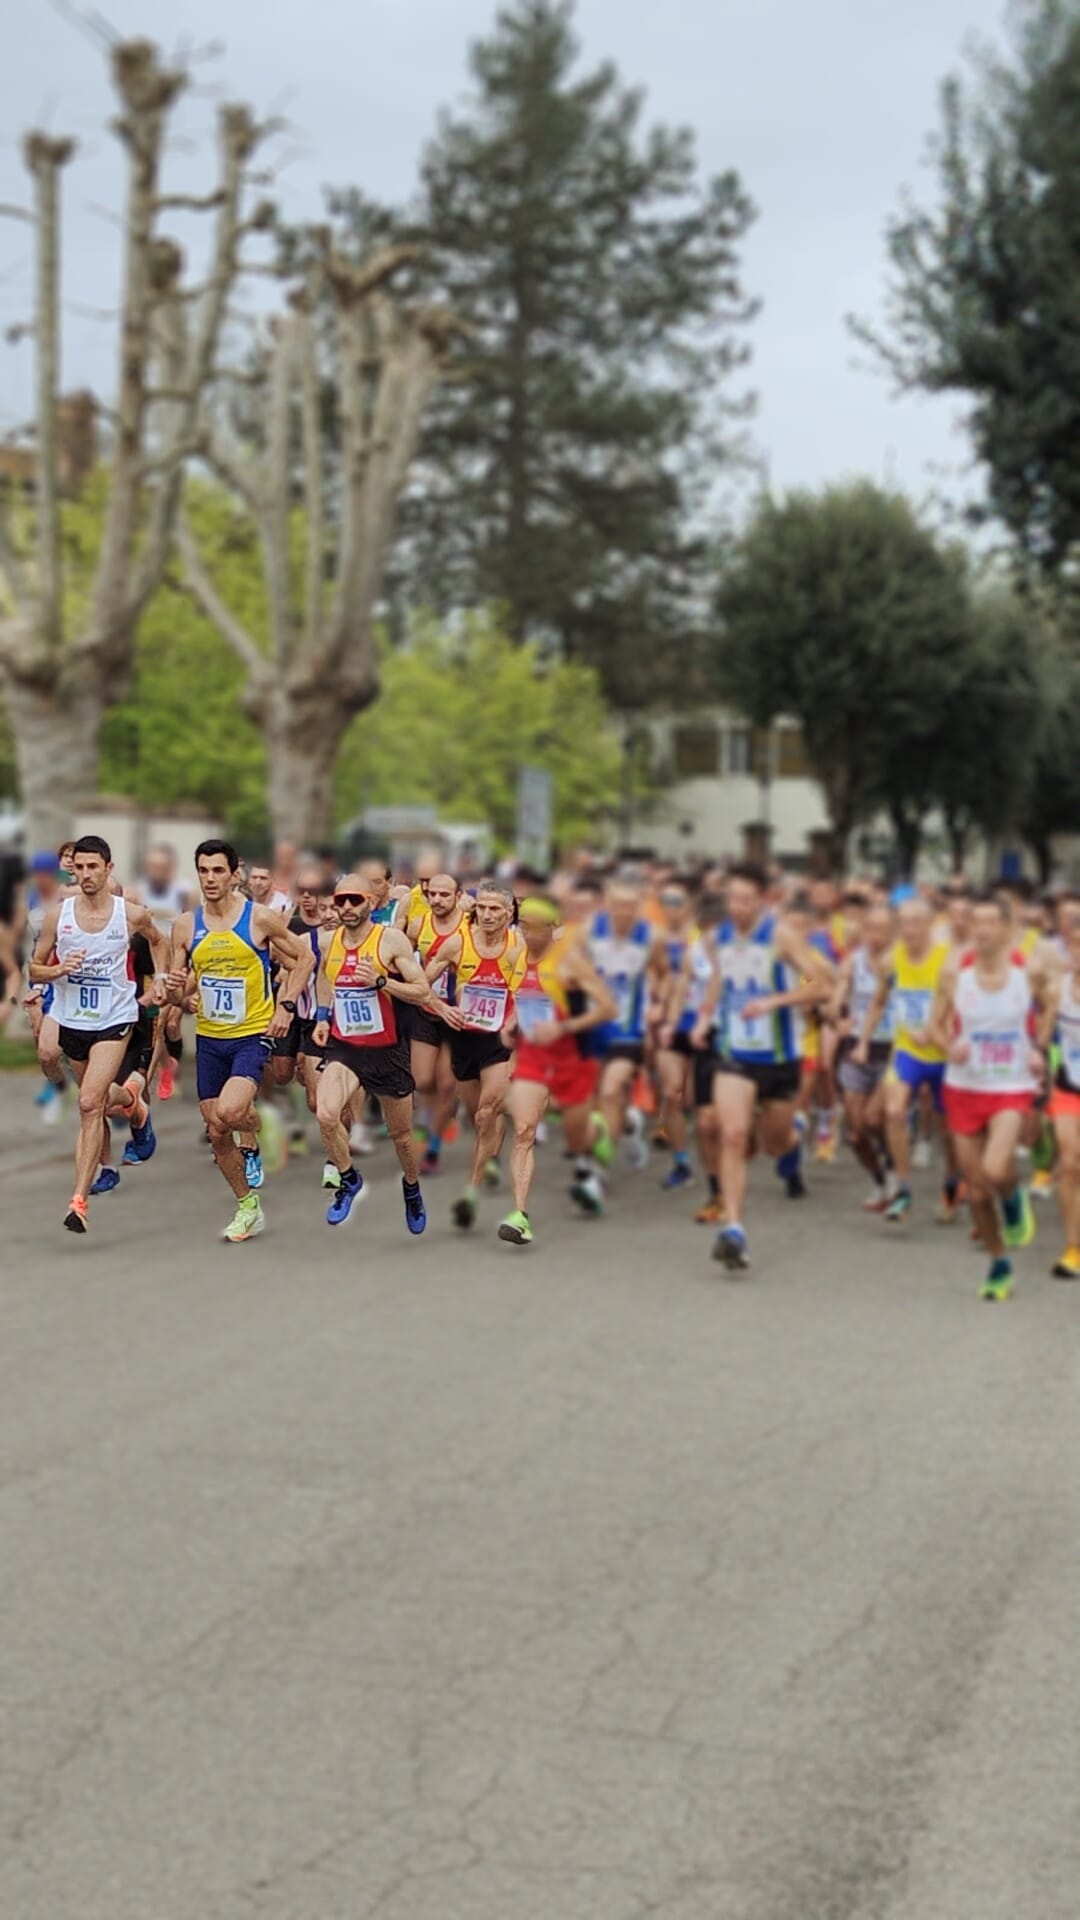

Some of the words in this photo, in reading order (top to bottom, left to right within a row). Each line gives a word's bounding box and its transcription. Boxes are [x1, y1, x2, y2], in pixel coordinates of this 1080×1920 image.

[80, 987, 99, 1009] 60
[214, 989, 233, 1011] 73
[467, 995, 497, 1018] 243
[343, 1000, 372, 1023] 195
